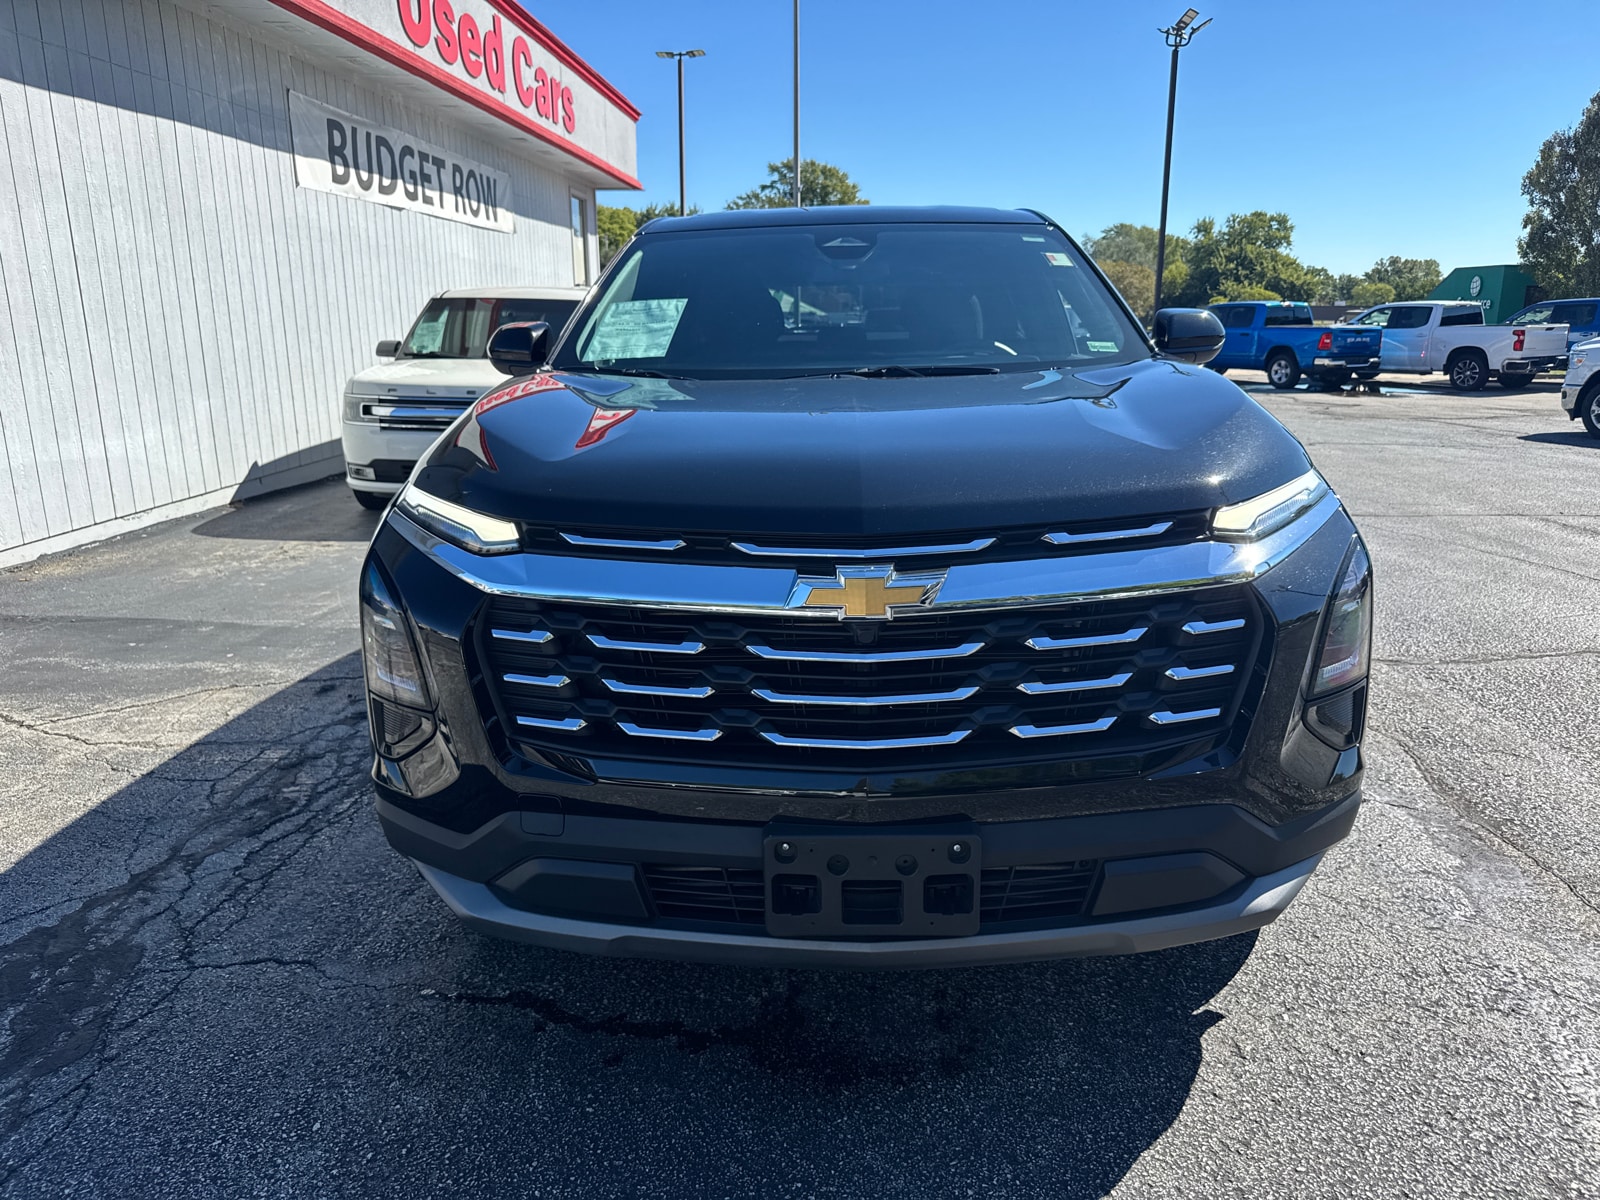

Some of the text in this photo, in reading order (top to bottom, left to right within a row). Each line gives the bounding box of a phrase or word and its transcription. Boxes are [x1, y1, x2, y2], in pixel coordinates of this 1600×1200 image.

[397, 0, 576, 134] Used Cars
[326, 118, 498, 223] BUDGET ROW
